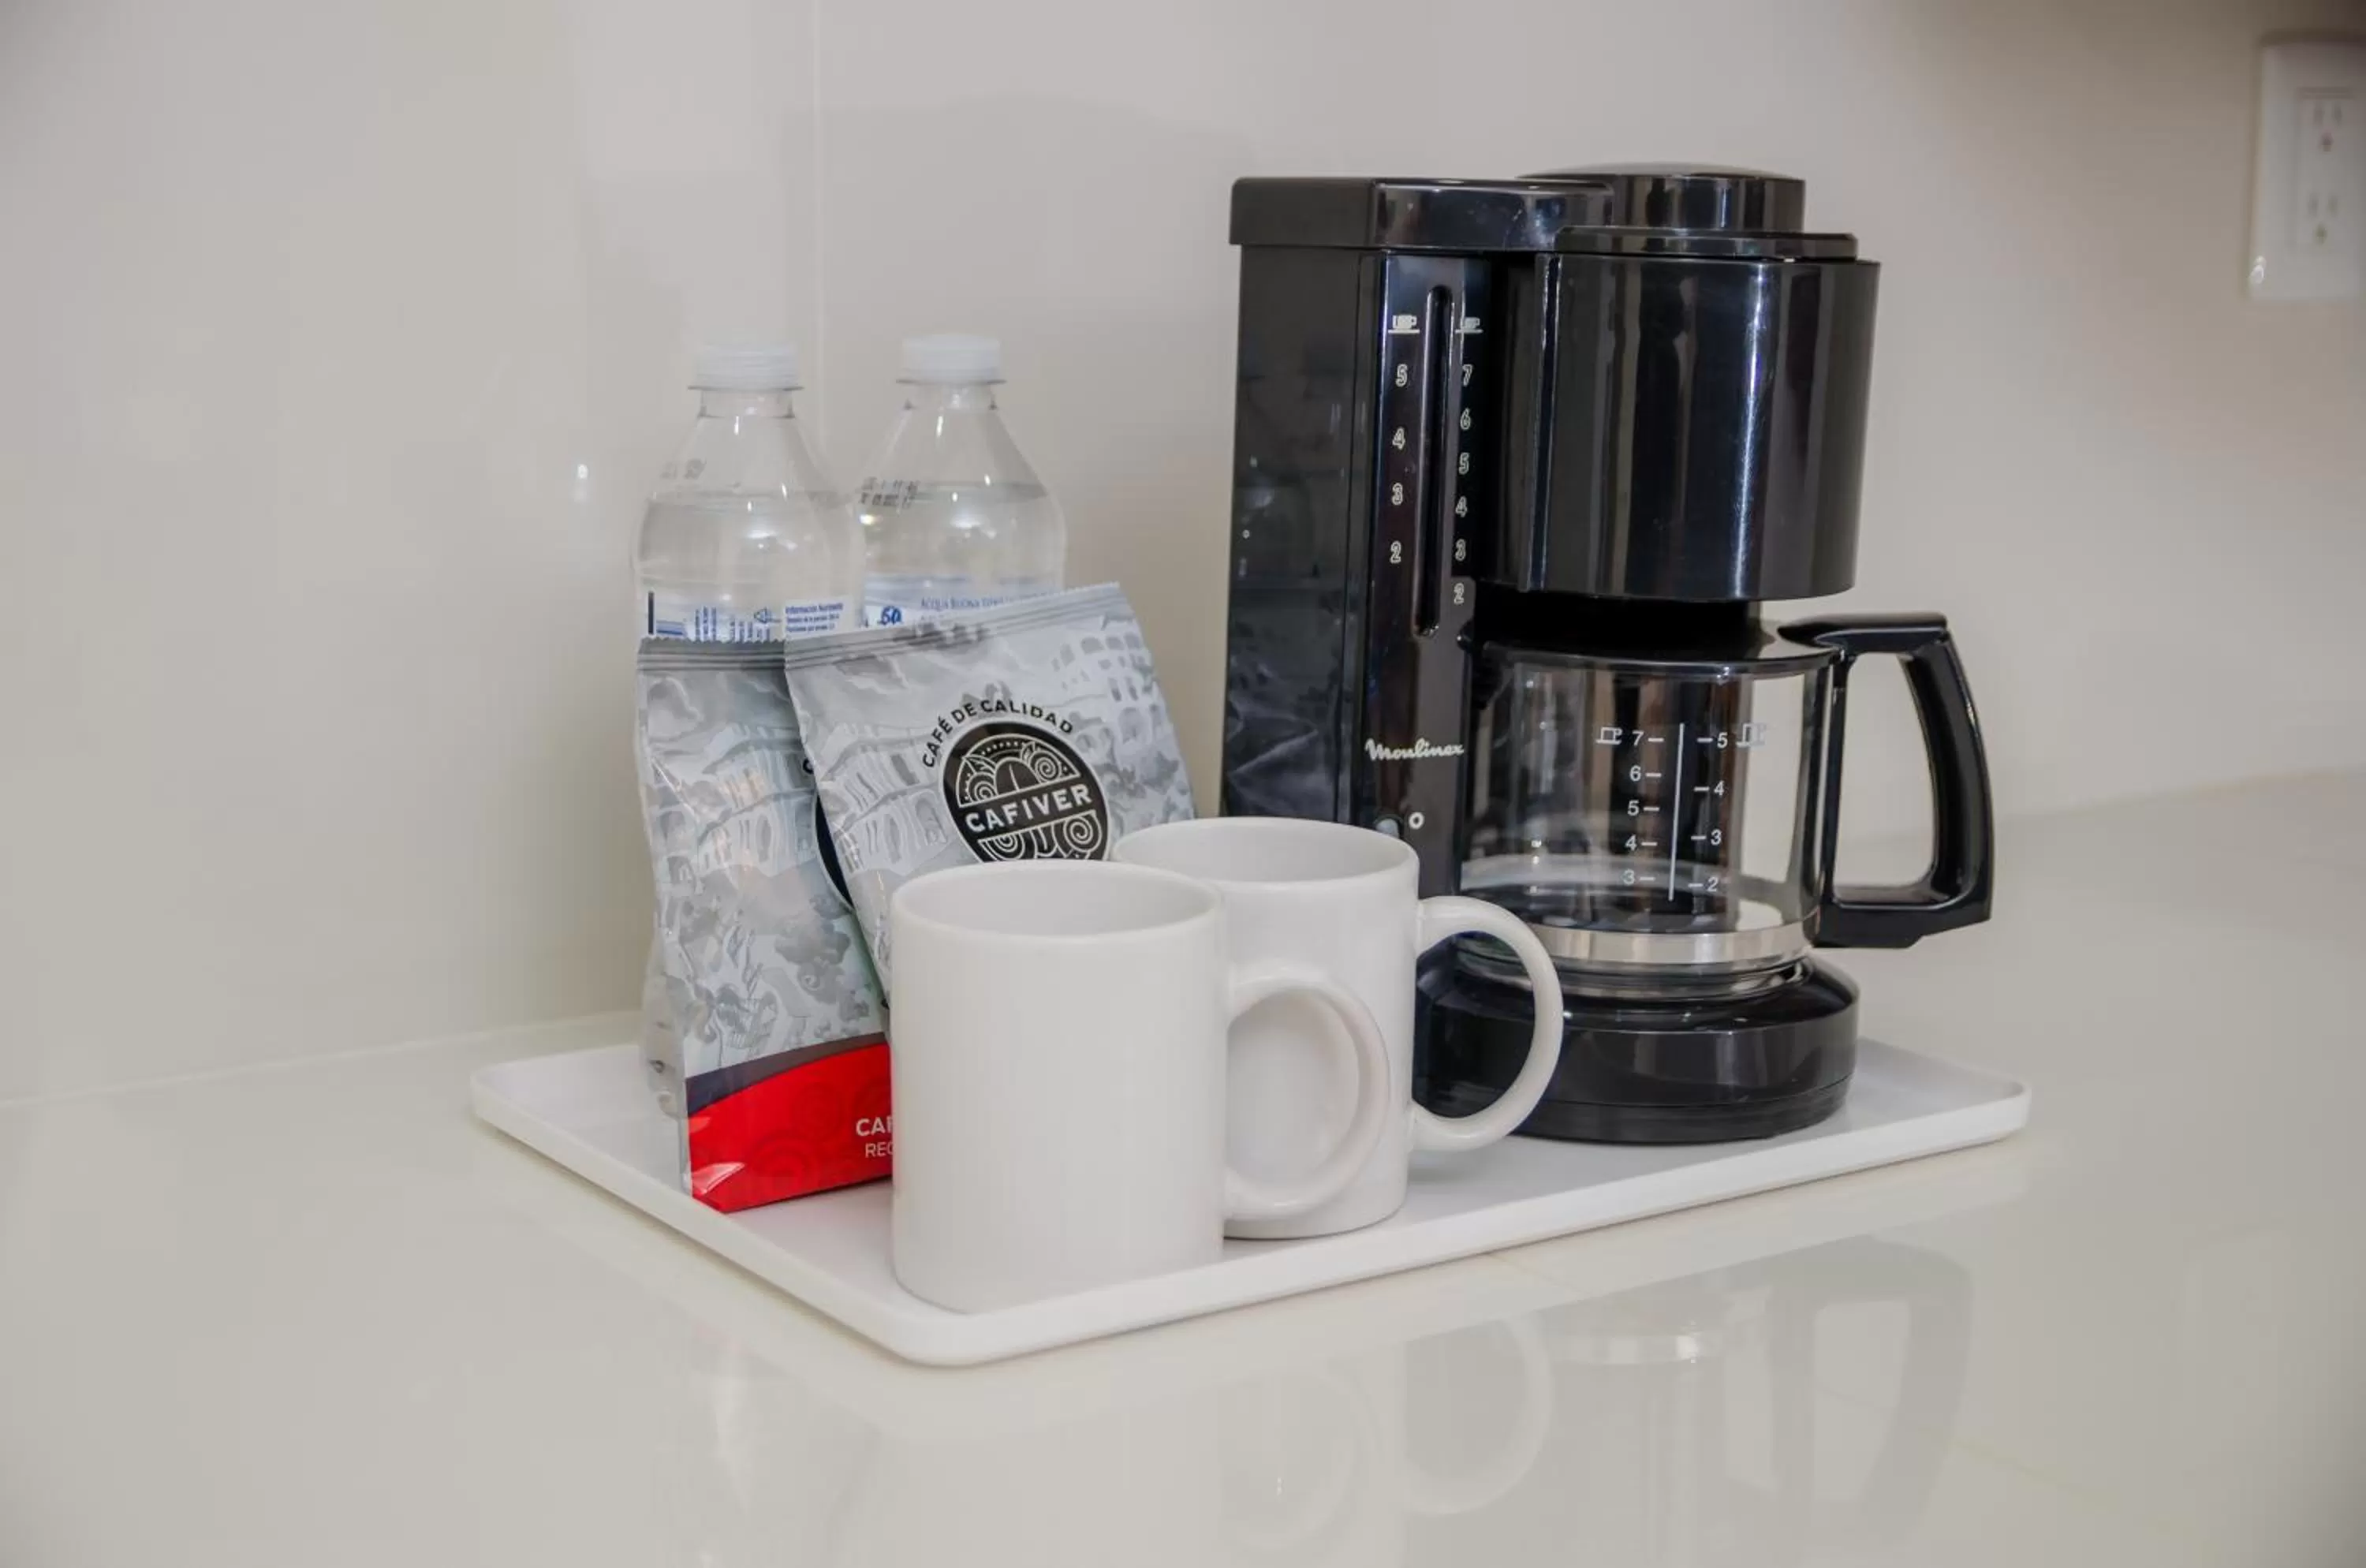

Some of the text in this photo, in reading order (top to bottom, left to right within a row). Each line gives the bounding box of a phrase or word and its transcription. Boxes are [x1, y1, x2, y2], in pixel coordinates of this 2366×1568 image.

[1395, 364, 1409, 386] 5
[1462, 364, 1473, 386] 7
[1460, 408, 1471, 430] 6
[1392, 427, 1405, 450] 4
[1458, 452, 1469, 474] 5
[1391, 482, 1403, 506] 3
[1455, 496, 1468, 517] 4
[1390, 540, 1401, 564] 2
[1455, 539, 1466, 561] 3
[1454, 583, 1465, 604] 2
[922, 700, 1073, 767] CAFÉ DE CALIDAD
[1632, 730, 1644, 746] 7
[1717, 732, 1728, 749] 5
[1364, 737, 1465, 761] Moulinex
[1629, 765, 1641, 782] 6
[1714, 780, 1725, 796] 4
[965, 783, 1092, 833] CAFIVER
[1627, 800, 1639, 816] 5
[1625, 834, 1637, 851] 4
[1711, 829, 1722, 846] 3
[1622, 869, 1635, 885] 3
[1707, 876, 1719, 892] 2
